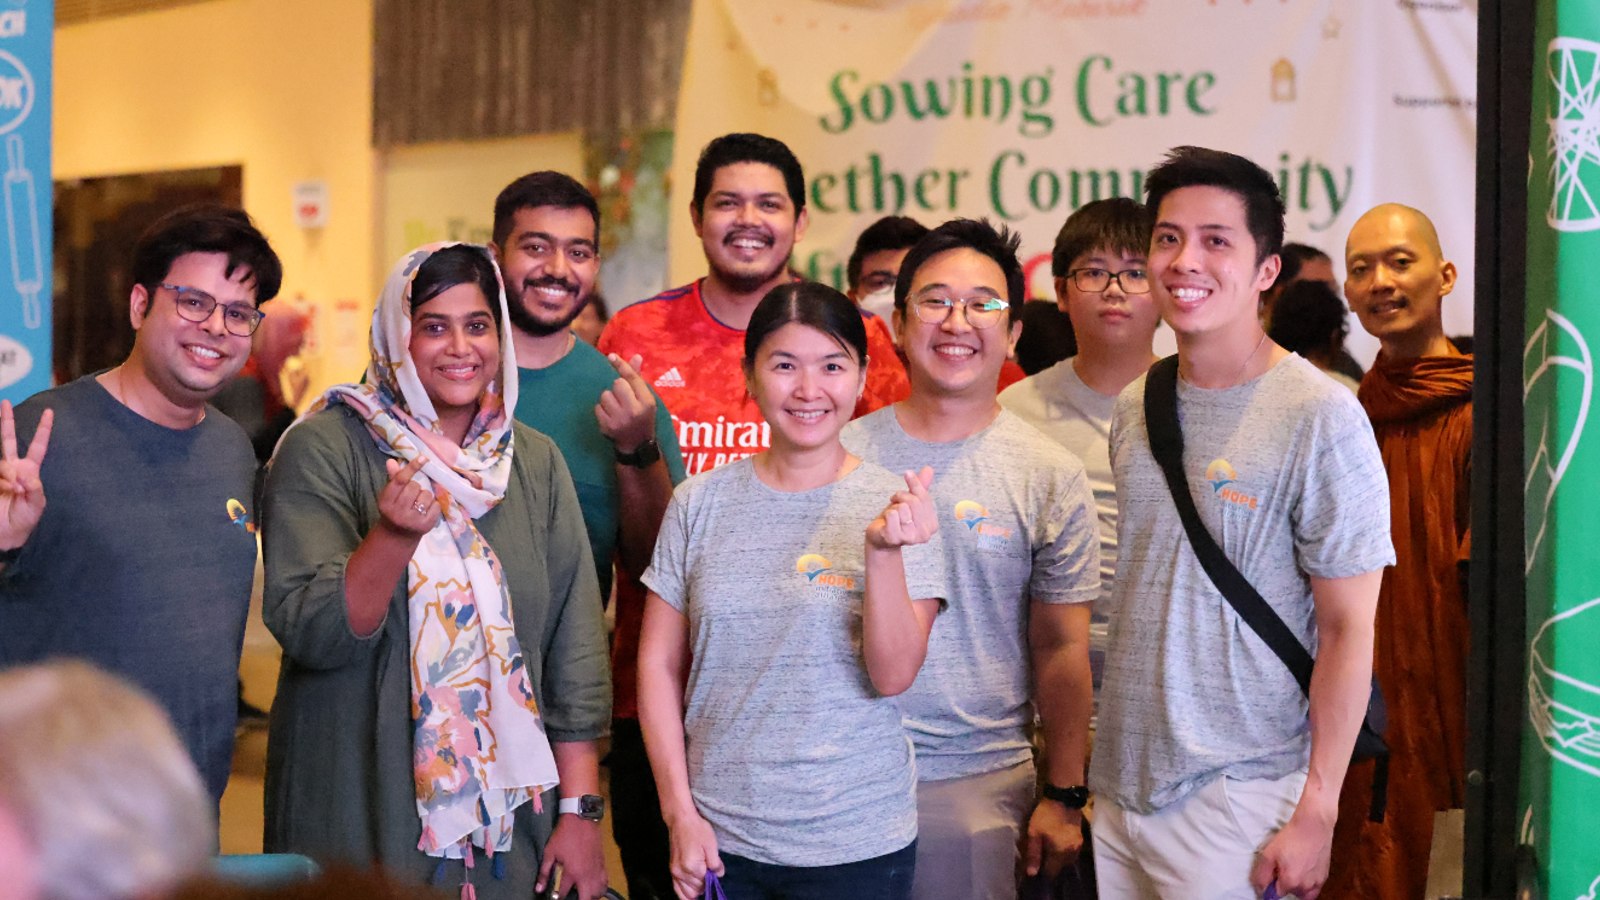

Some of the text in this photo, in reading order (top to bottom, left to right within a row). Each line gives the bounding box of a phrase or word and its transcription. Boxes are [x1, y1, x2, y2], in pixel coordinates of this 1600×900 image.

[819, 54, 1220, 138] Sowing Care
[809, 150, 1355, 231] ether Comity
[671, 414, 772, 448] mirat
[1220, 487, 1259, 510] HOPE
[817, 574, 855, 590] HOPE
